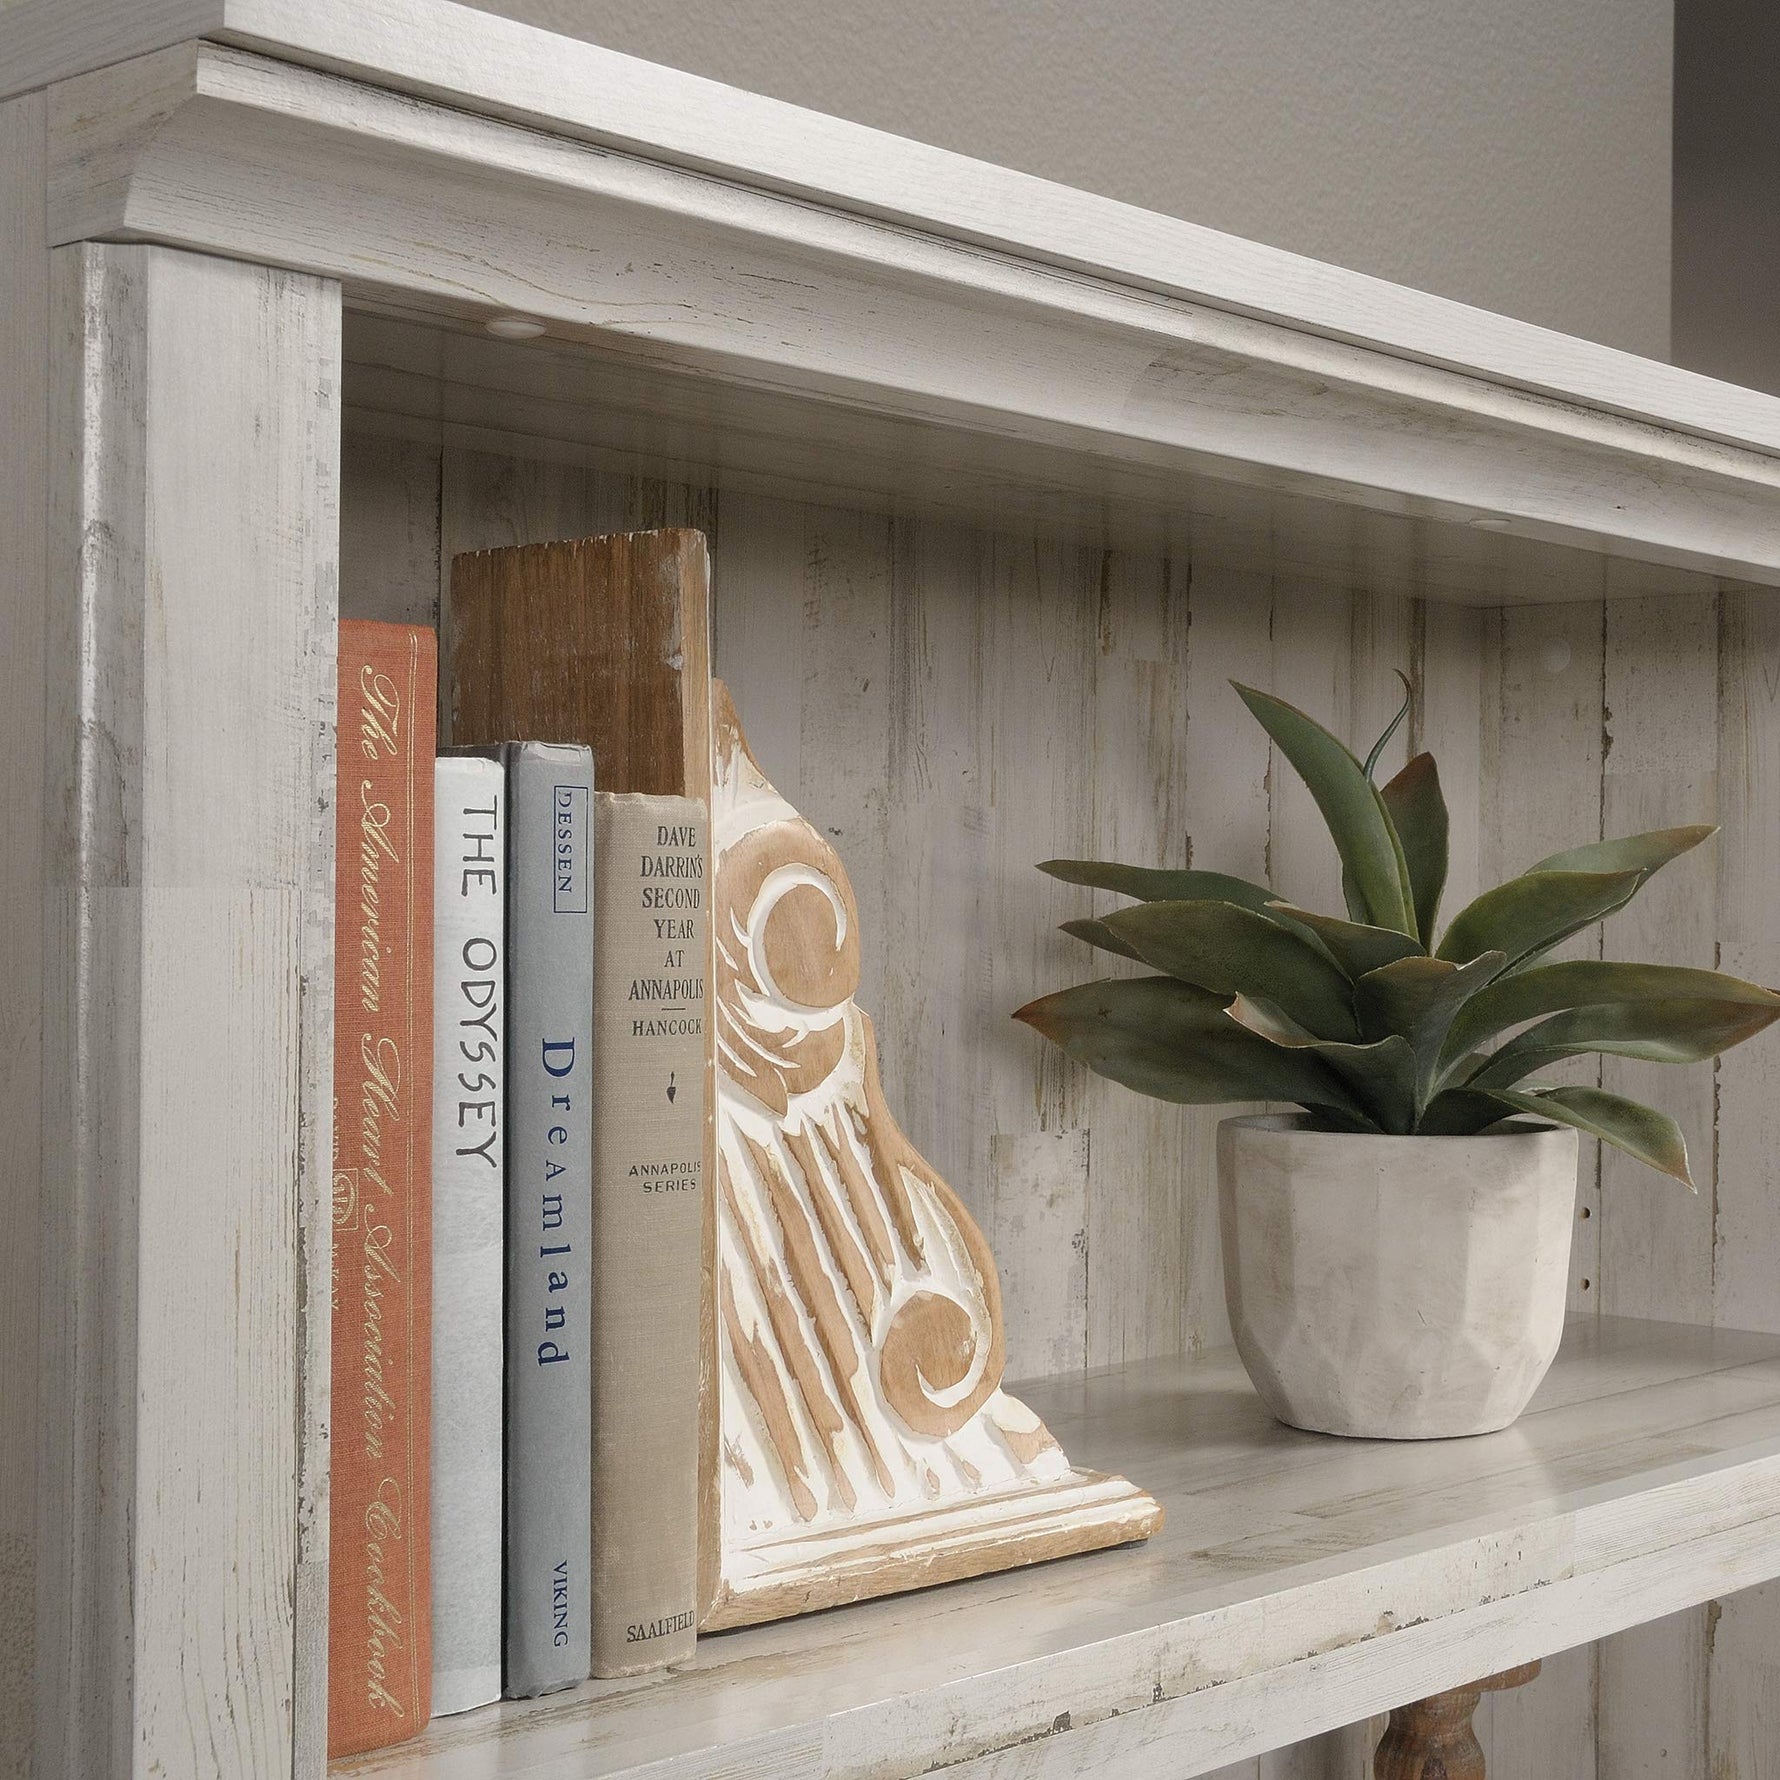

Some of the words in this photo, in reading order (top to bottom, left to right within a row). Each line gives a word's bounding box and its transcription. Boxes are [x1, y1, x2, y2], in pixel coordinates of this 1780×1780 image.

[359, 664, 399, 761] The
[461, 794, 498, 897] THE
[557, 790, 573, 894] DESSEN
[656, 826, 697, 848] DAVE
[640, 854, 703, 879] DARRIN'S
[359, 781, 399, 1013] American
[641, 887, 700, 909] SECOND
[653, 918, 695, 939] YEAR
[664, 949, 685, 967] AT
[628, 978, 703, 1001] ANNAPOLIS
[632, 1017, 702, 1037] HANCOCK
[456, 937, 498, 1169] ODYSSEY
[360, 1033, 401, 1196] Heart
[628, 1160, 701, 1177] ANNAPOLIS
[643, 1178, 697, 1193] SERIES
[363, 1203, 401, 1459] Association
[364, 1477, 405, 1718] Cookbook
[553, 1559, 568, 1647] VIKING
[626, 1610, 695, 1643] SAALFIELD
